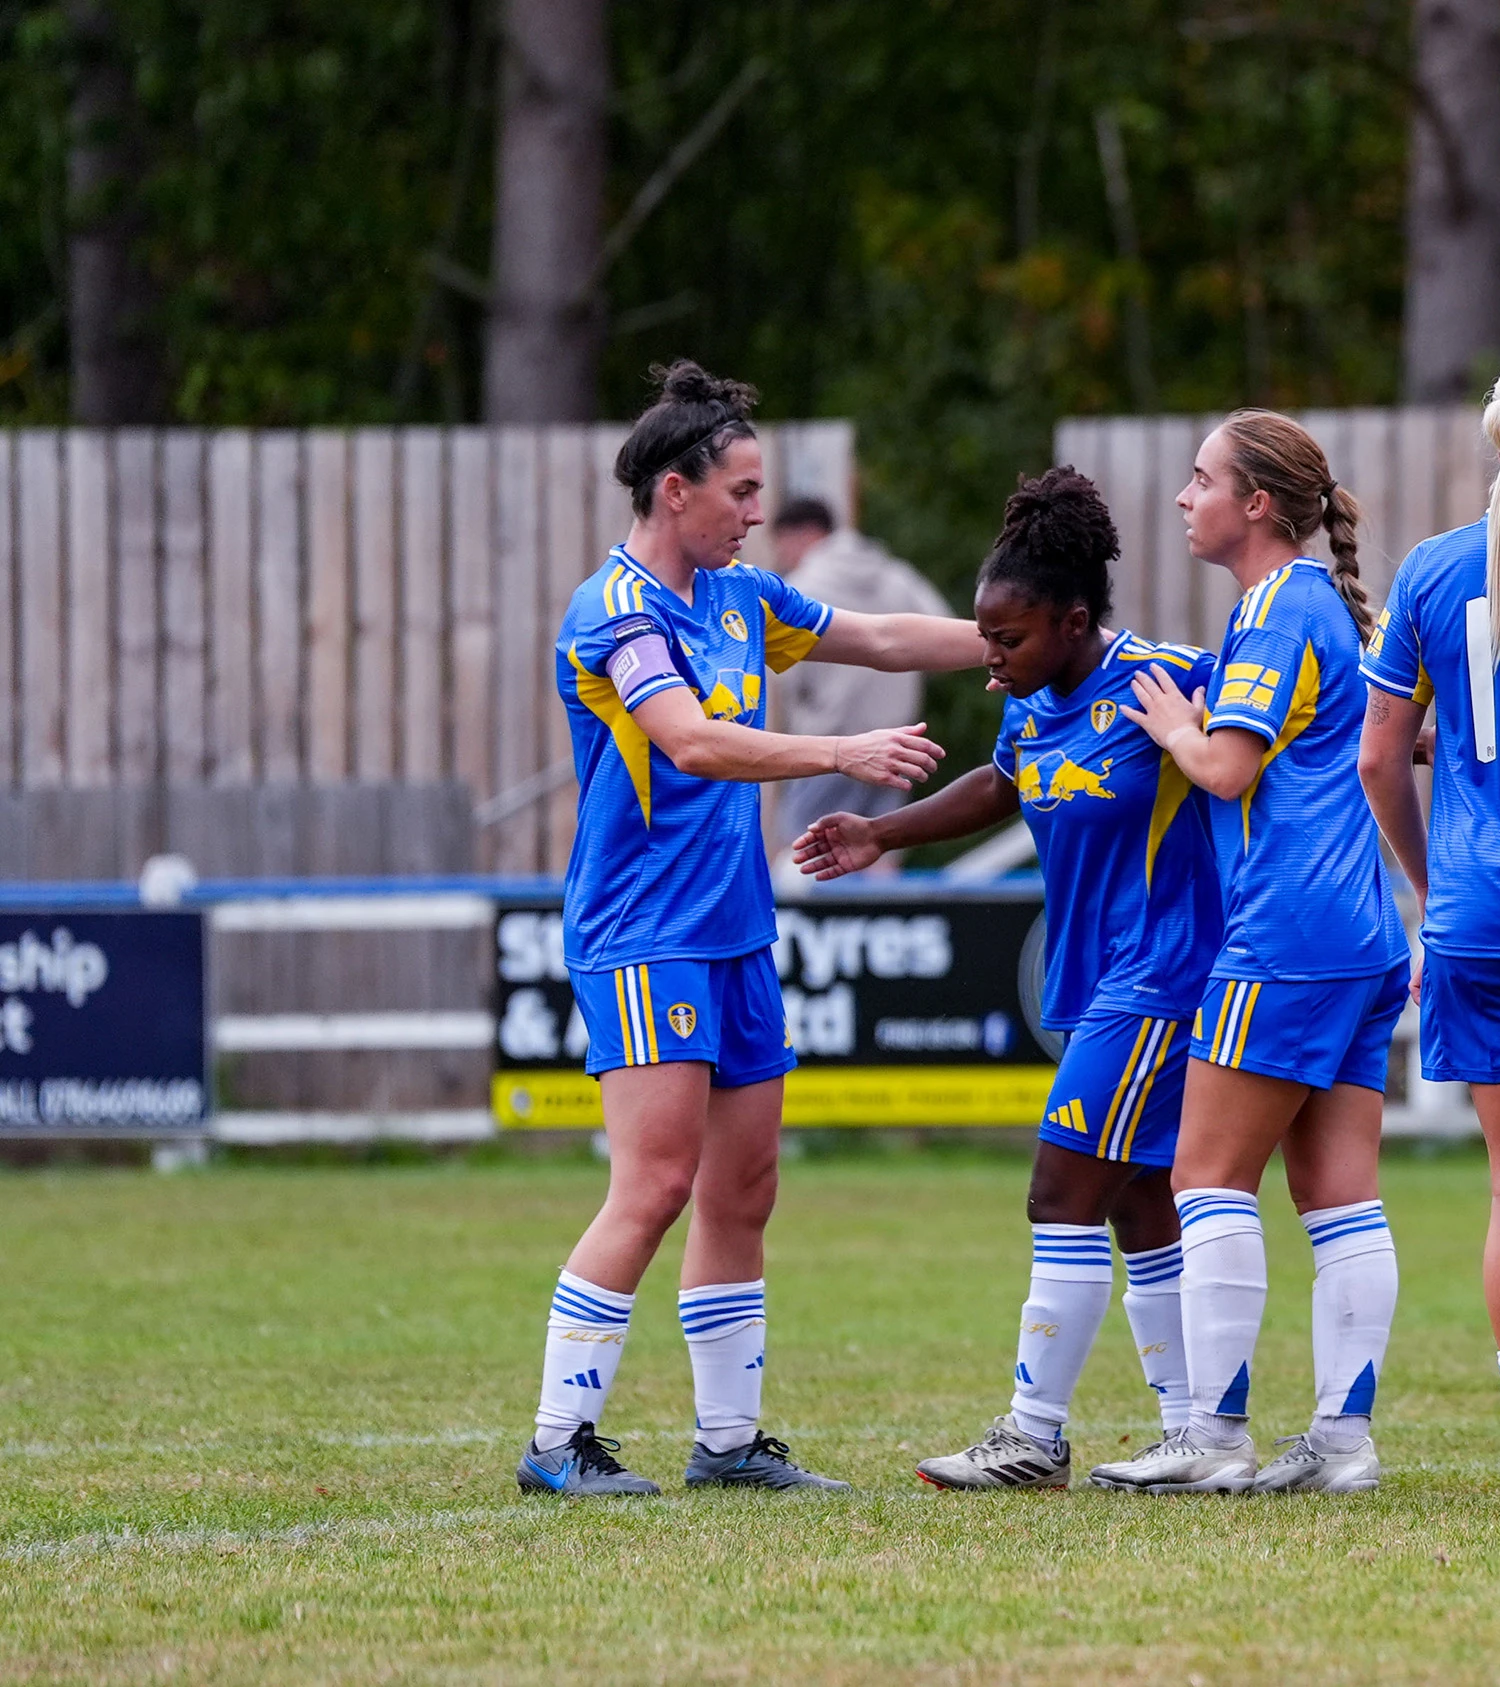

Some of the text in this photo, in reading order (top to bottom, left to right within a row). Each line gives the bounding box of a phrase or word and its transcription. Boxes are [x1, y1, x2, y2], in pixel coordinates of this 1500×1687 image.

[773, 908, 952, 990] Tyres
[501, 987, 559, 1059] &
[782, 980, 855, 1056] td
